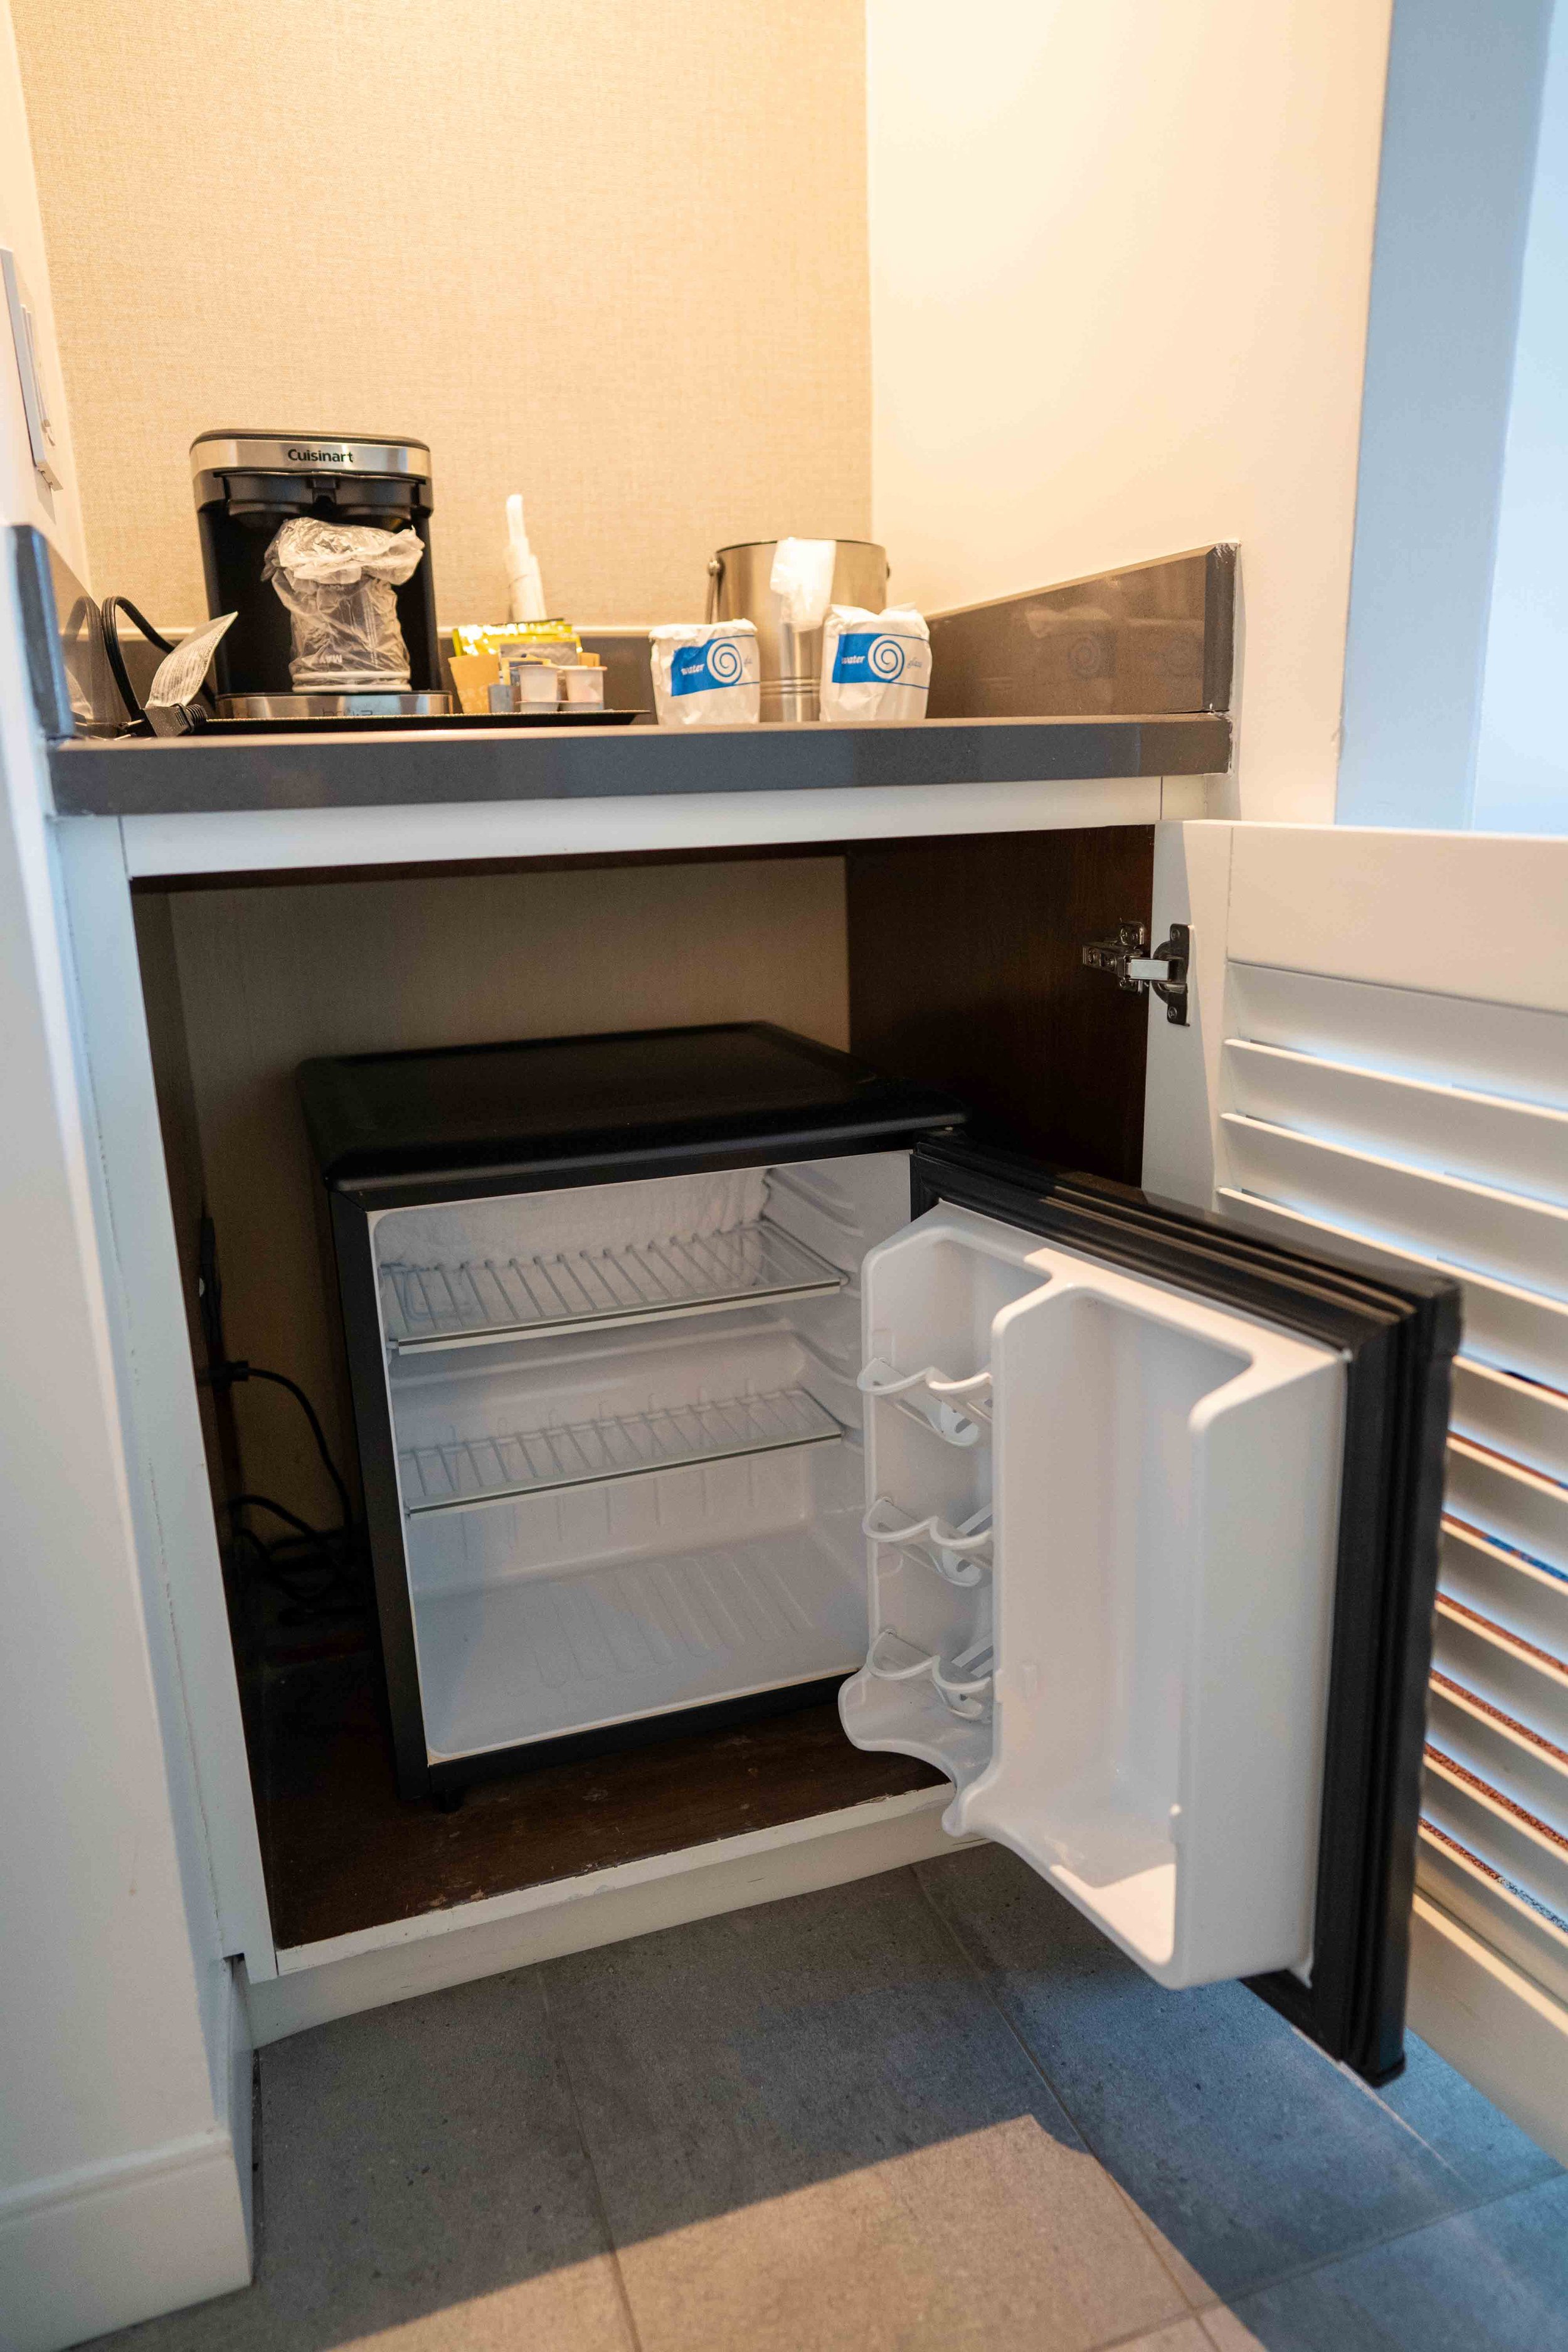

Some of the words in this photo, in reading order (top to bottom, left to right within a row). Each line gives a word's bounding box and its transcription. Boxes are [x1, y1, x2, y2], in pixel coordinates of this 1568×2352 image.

[287, 448, 354, 464] Cuisinart
[840, 655, 866, 664] water
[681, 664, 705, 675] water
